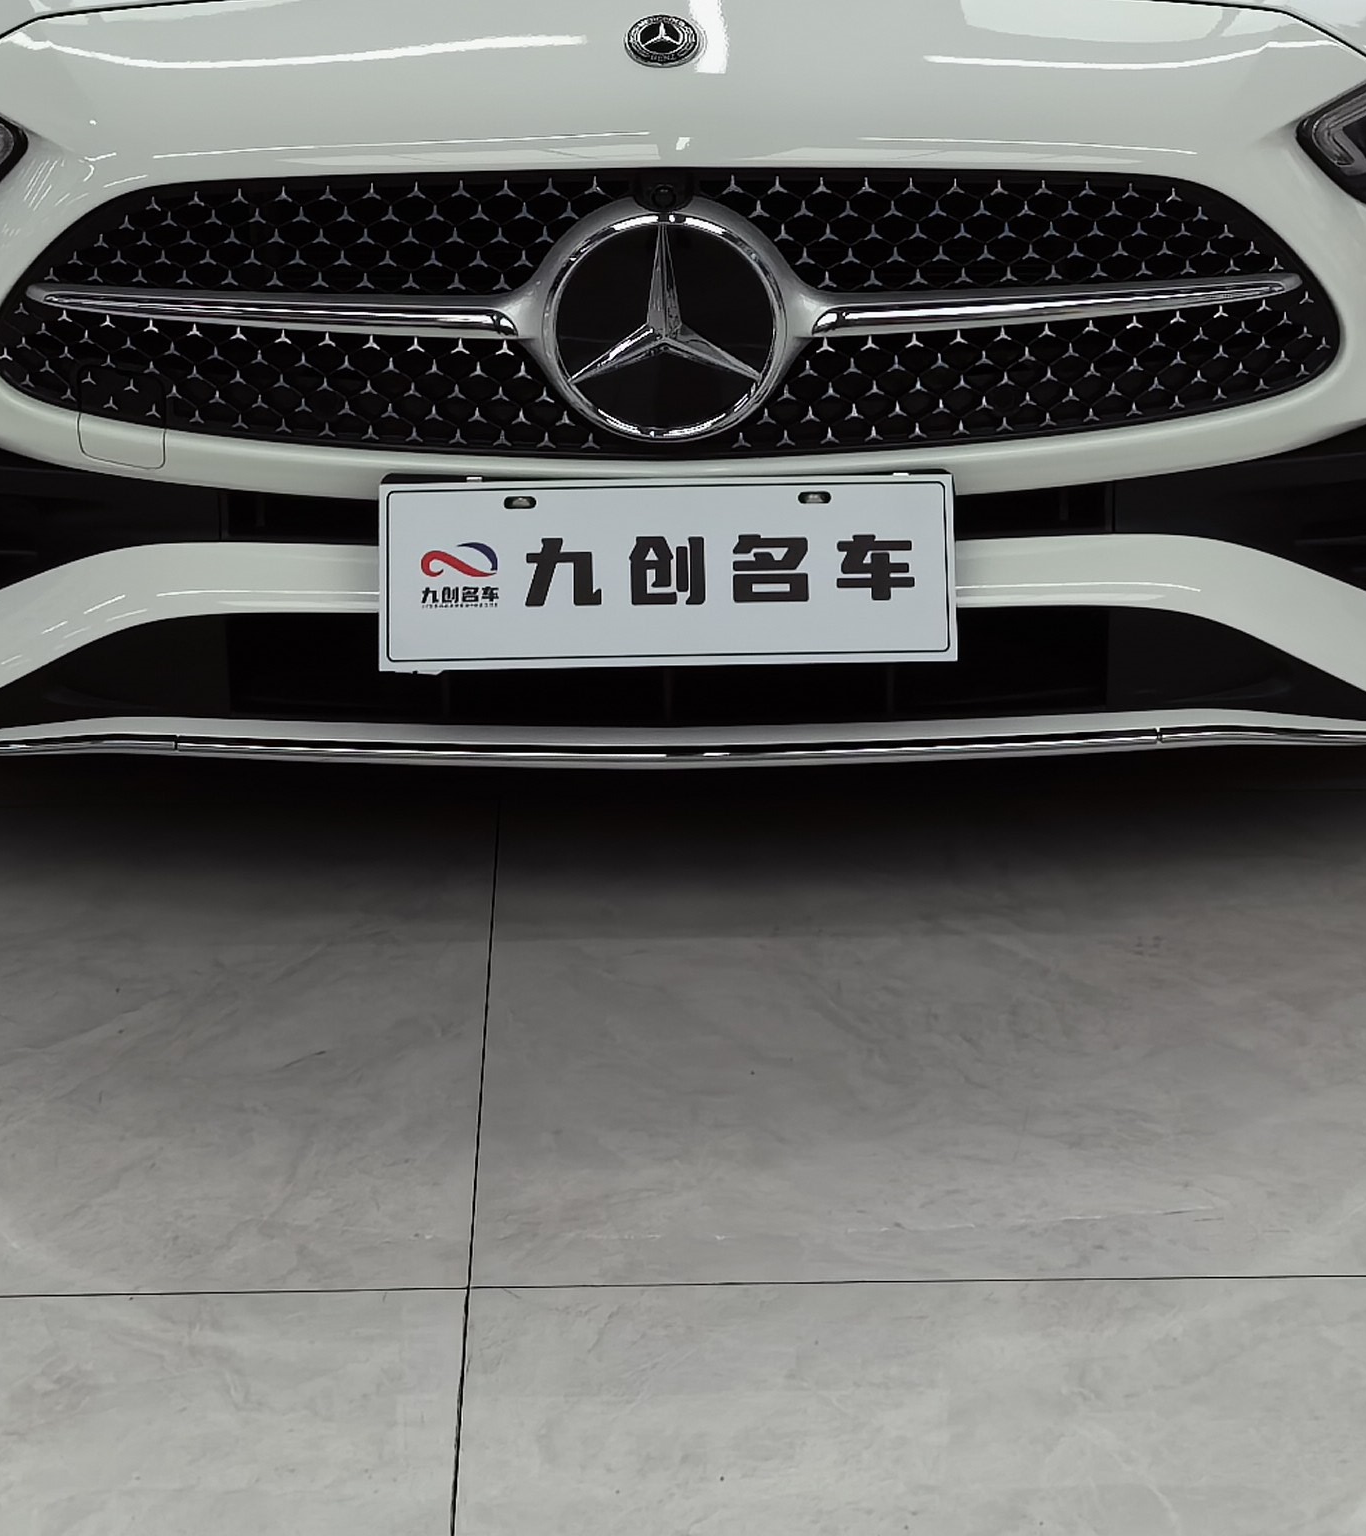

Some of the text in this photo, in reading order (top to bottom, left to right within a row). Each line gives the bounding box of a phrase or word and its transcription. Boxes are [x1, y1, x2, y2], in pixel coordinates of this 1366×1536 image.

[525, 534, 915, 607] 九创名车
[421, 586, 500, 603] 九创名车
